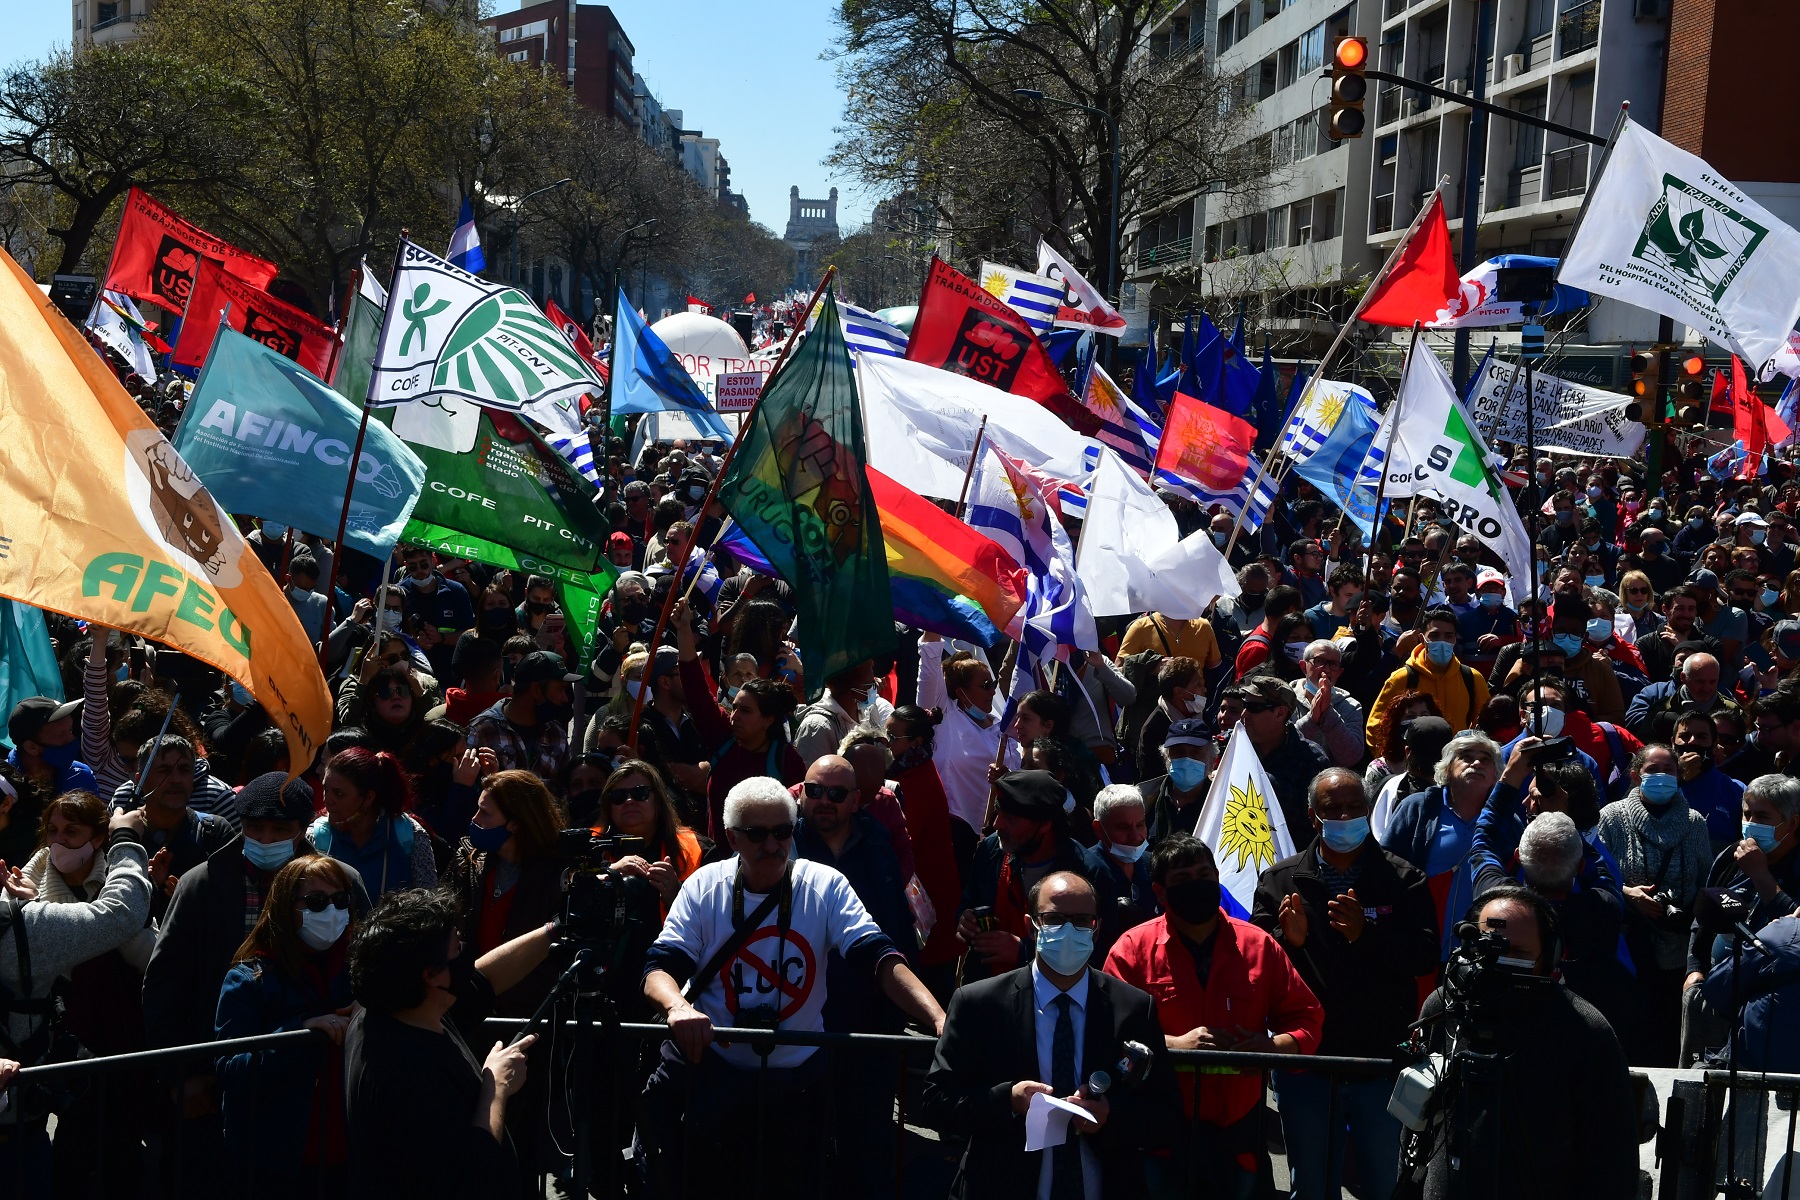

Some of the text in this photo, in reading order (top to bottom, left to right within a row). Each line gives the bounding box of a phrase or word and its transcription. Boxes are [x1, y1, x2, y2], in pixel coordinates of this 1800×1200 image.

[1682, 184, 1748, 224] TRABAJO Y
[134, 202, 208, 250] TRABAJADORES
[212, 245, 226, 255] DE
[159, 269, 192, 297] US
[1599, 274, 1621, 287] FUS
[1626, 261, 1669, 288] SINDICATO
[1669, 280, 1680, 291] DE
[1722, 253, 1747, 288] SALUD
[1599, 263, 1729, 329] DEL HOSPITAL EVANGELICO DEL UR
[1479, 307, 1510, 316] PIT-CNT
[496, 333, 560, 378] PIT-CNT
[957, 345, 1010, 382] UST
[391, 374, 420, 391] COFE
[719, 388, 761, 396] PASANDO
[727, 377, 756, 385] ESTOY
[1535, 379, 1548, 394] DE
[1564, 388, 1586, 407] CASA
[721, 398, 757, 407] HAMBR
[1478, 396, 1499, 413] POR
[193, 435, 203, 443] del
[203, 437, 229, 452] Instituto
[229, 447, 255, 458] Nacional
[195, 428, 228, 445] Asociación
[199, 398, 383, 483] AFINCO
[1427, 444, 1452, 472] S
[1389, 473, 1413, 483] COF
[430, 480, 497, 511] COFE
[345, 518, 380, 536] IT-CNT
[523, 513, 595, 550] PIT CNT
[411, 536, 479, 558] CLATE
[521, 558, 585, 585] COFE
[734, 956, 805, 995] LUC
